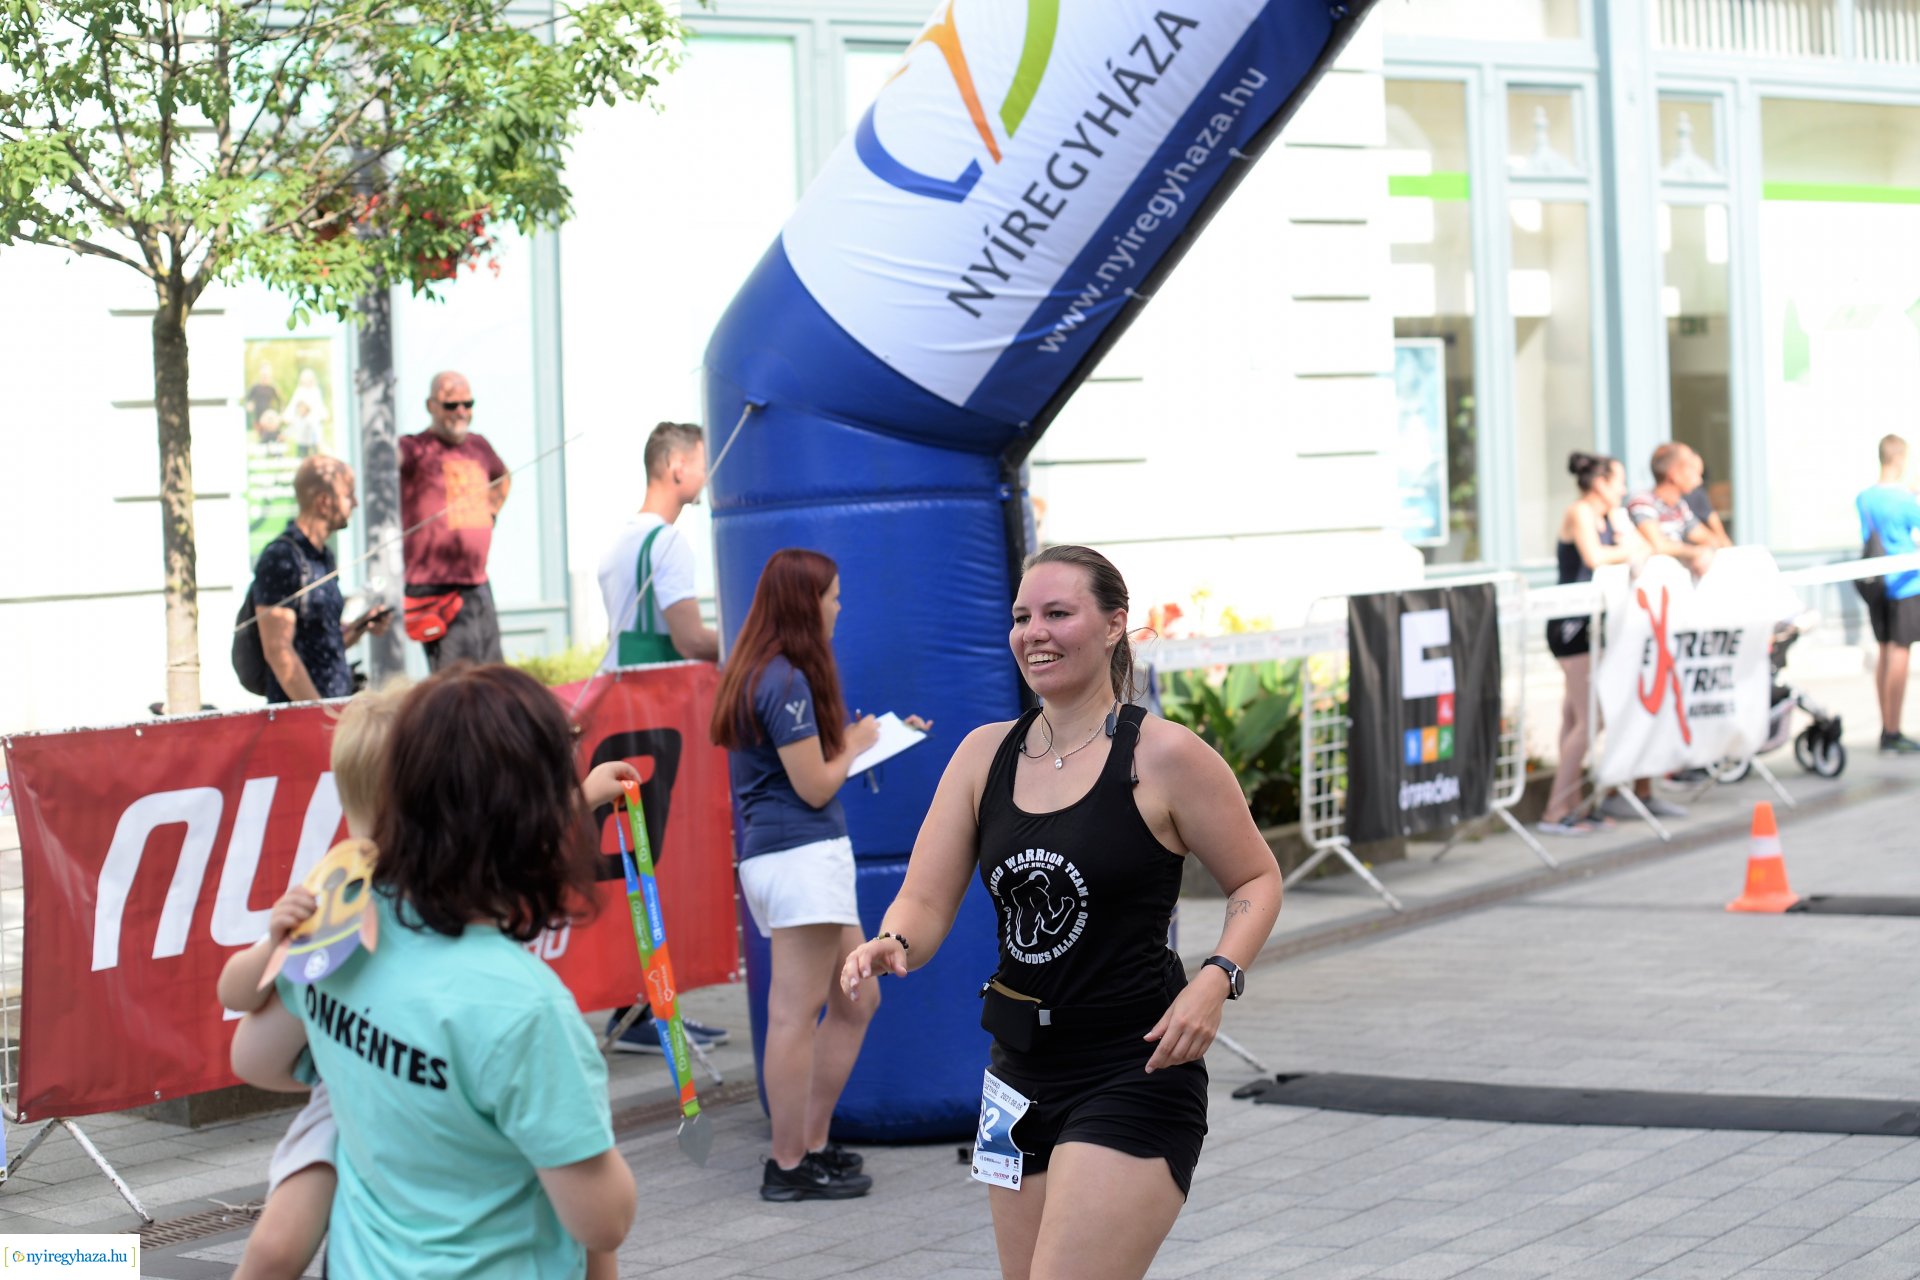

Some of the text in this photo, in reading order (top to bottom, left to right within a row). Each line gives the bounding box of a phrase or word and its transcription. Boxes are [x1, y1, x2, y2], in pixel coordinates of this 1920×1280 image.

[947, 9, 1198, 318] NYÍREGYHÁZA
[1038, 66, 1267, 354] www.nyiregyhaza.hu
[1004, 848, 1065, 870] WARRIOR
[1064, 862, 1089, 897] TEAM
[1051, 911, 1089, 959] ALLANDO
